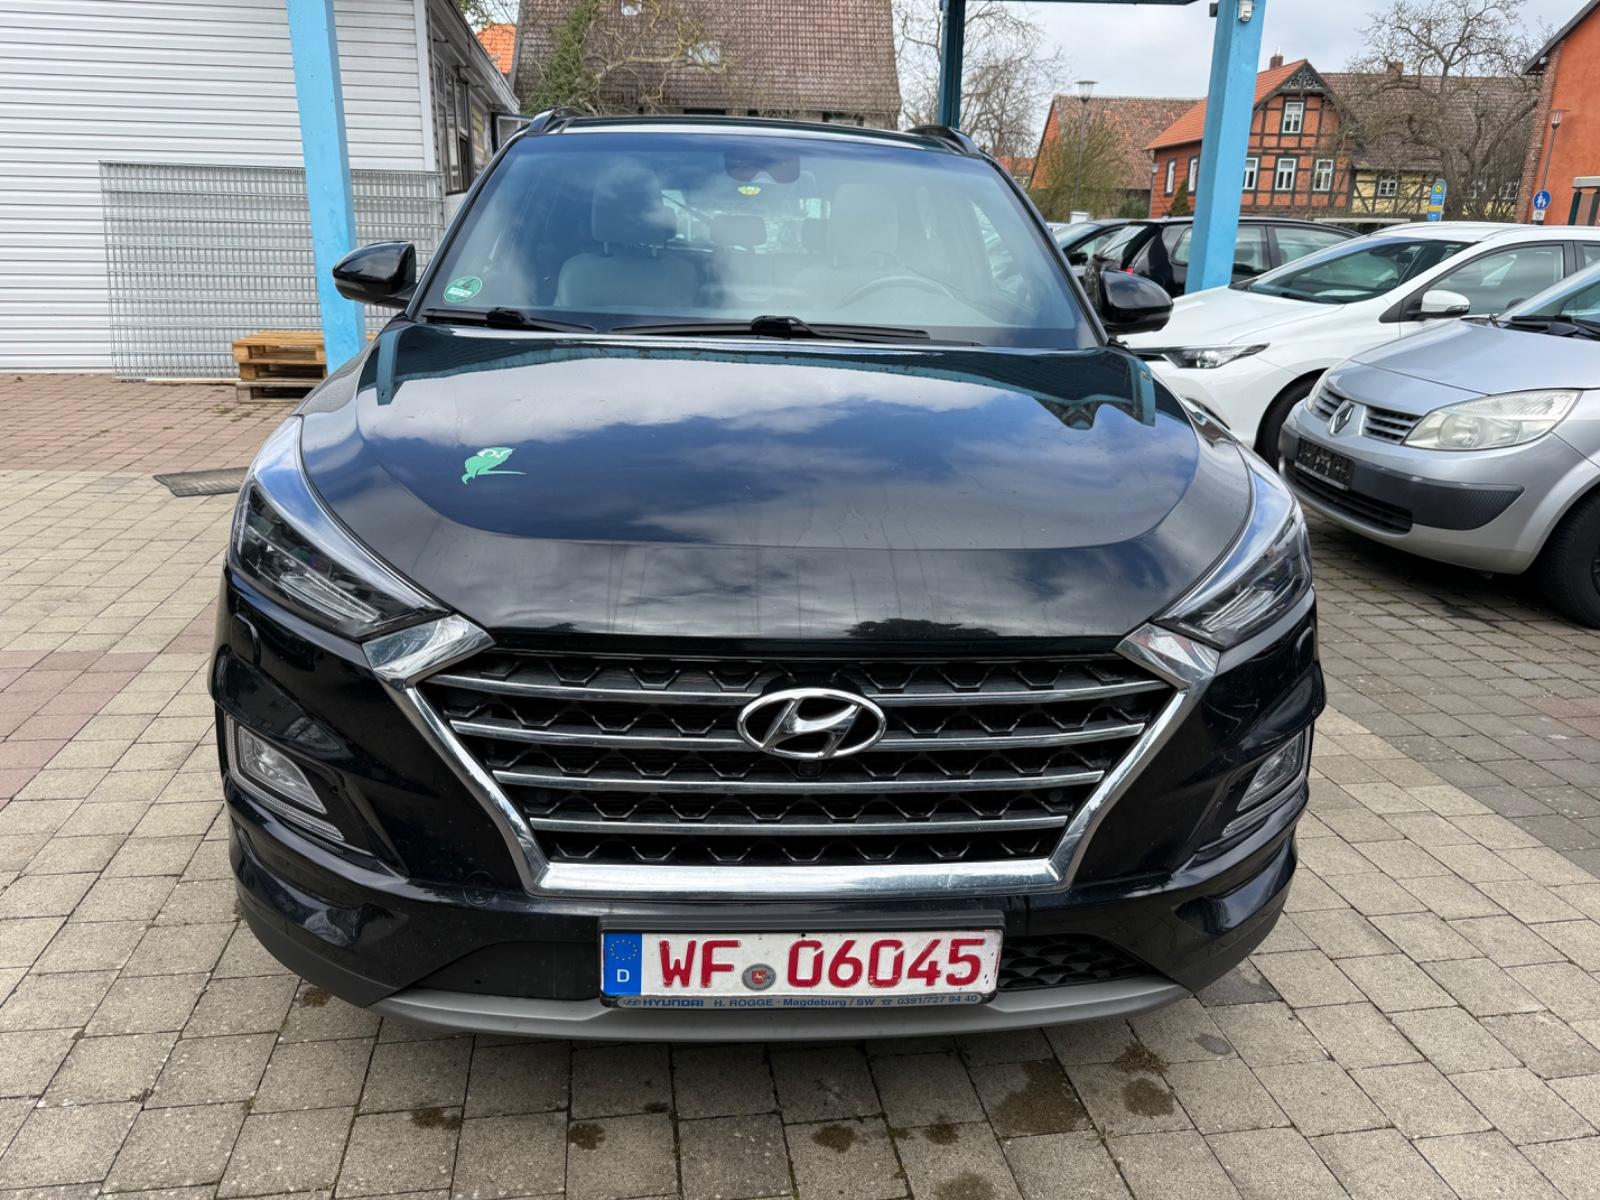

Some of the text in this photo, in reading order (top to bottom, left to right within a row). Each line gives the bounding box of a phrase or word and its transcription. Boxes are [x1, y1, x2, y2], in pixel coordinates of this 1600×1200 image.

[658, 938, 986, 988] WF 06045
[616, 968, 630, 983] D
[643, 998, 704, 1007] HYUNDAI
[714, 998, 726, 1007] H.
[730, 998, 773, 1007] ROGGE
[783, 997, 847, 1008] Magdeburg
[857, 997, 875, 1007] SW
[897, 995, 945, 1006] 0391/727
[949, 994, 961, 1003] 94
[965, 993, 978, 1003] 40
